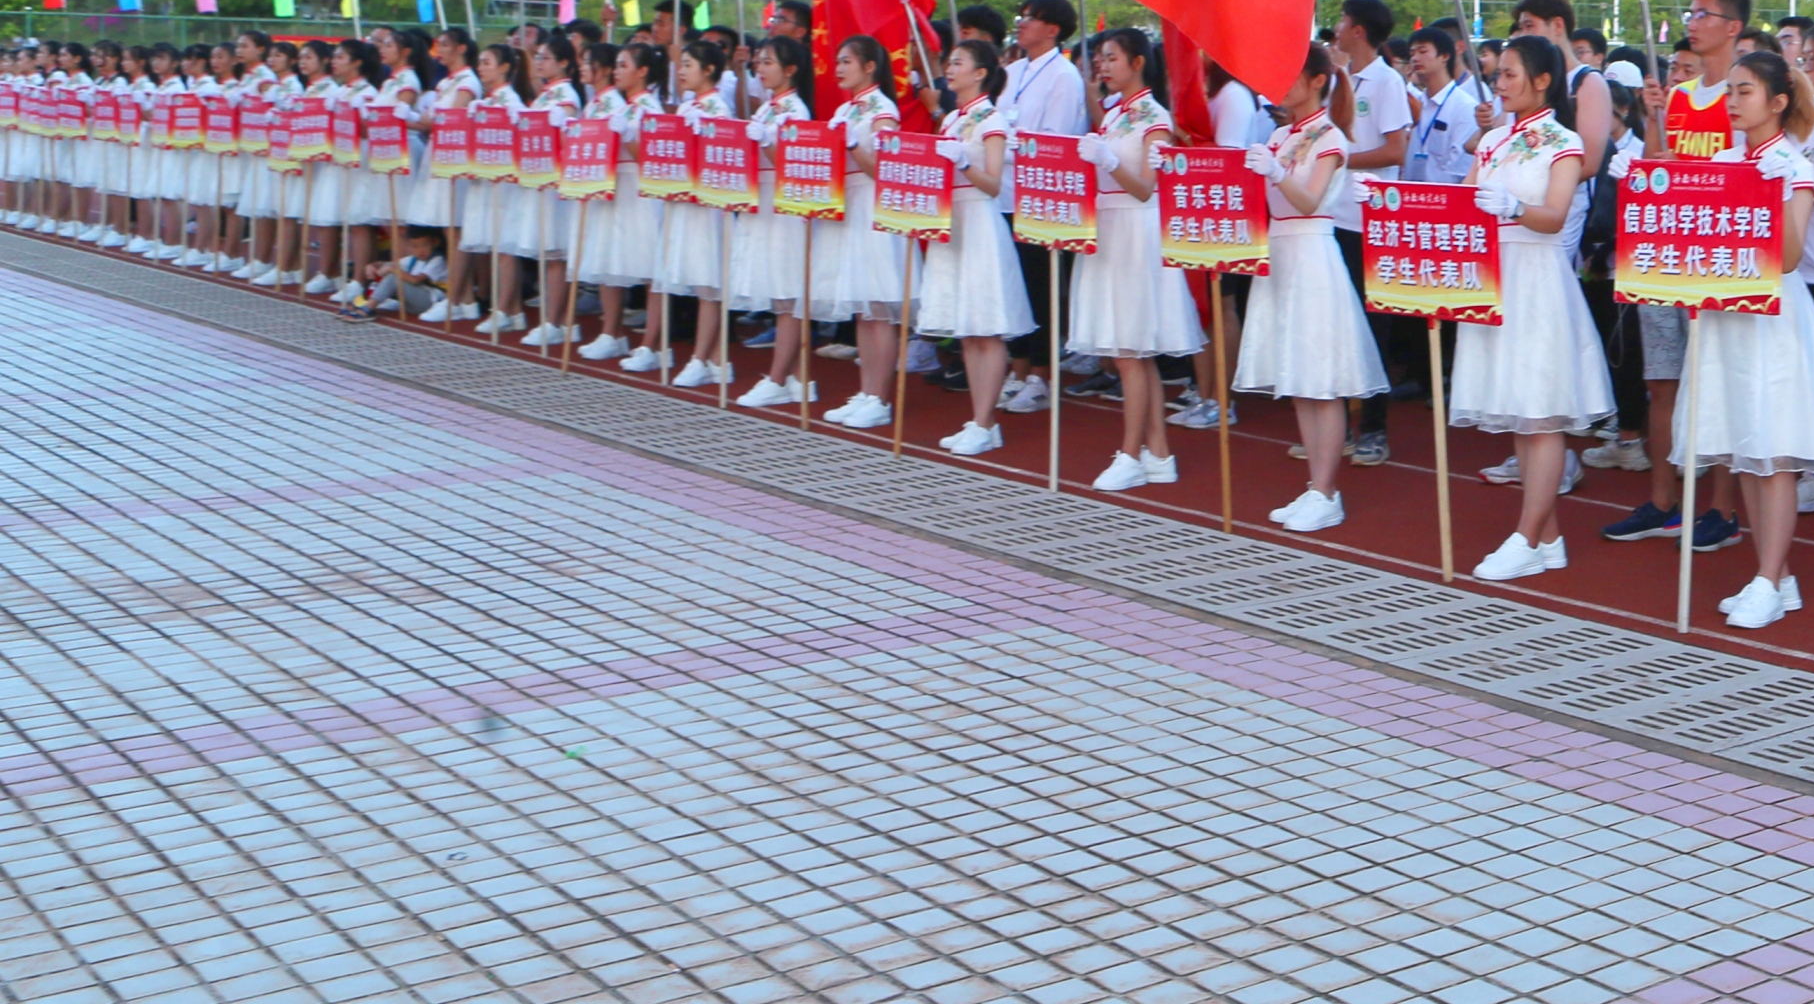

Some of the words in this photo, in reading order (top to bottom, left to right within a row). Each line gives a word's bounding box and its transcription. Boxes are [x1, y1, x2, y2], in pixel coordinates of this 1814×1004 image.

[1016, 164, 1086, 196] 马克思主义学院
[879, 187, 939, 216] 学生代表队
[1019, 194, 1083, 226] 学生代表队
[1172, 182, 1245, 212] 音乐学院
[1168, 214, 1252, 244] 学生代表队
[1367, 219, 1488, 254] 经济与管理学院
[1623, 202, 1772, 239] 信息科学技术学院
[1376, 255, 1483, 291] 学生代表队
[1633, 242, 1761, 279] 学生代表队
